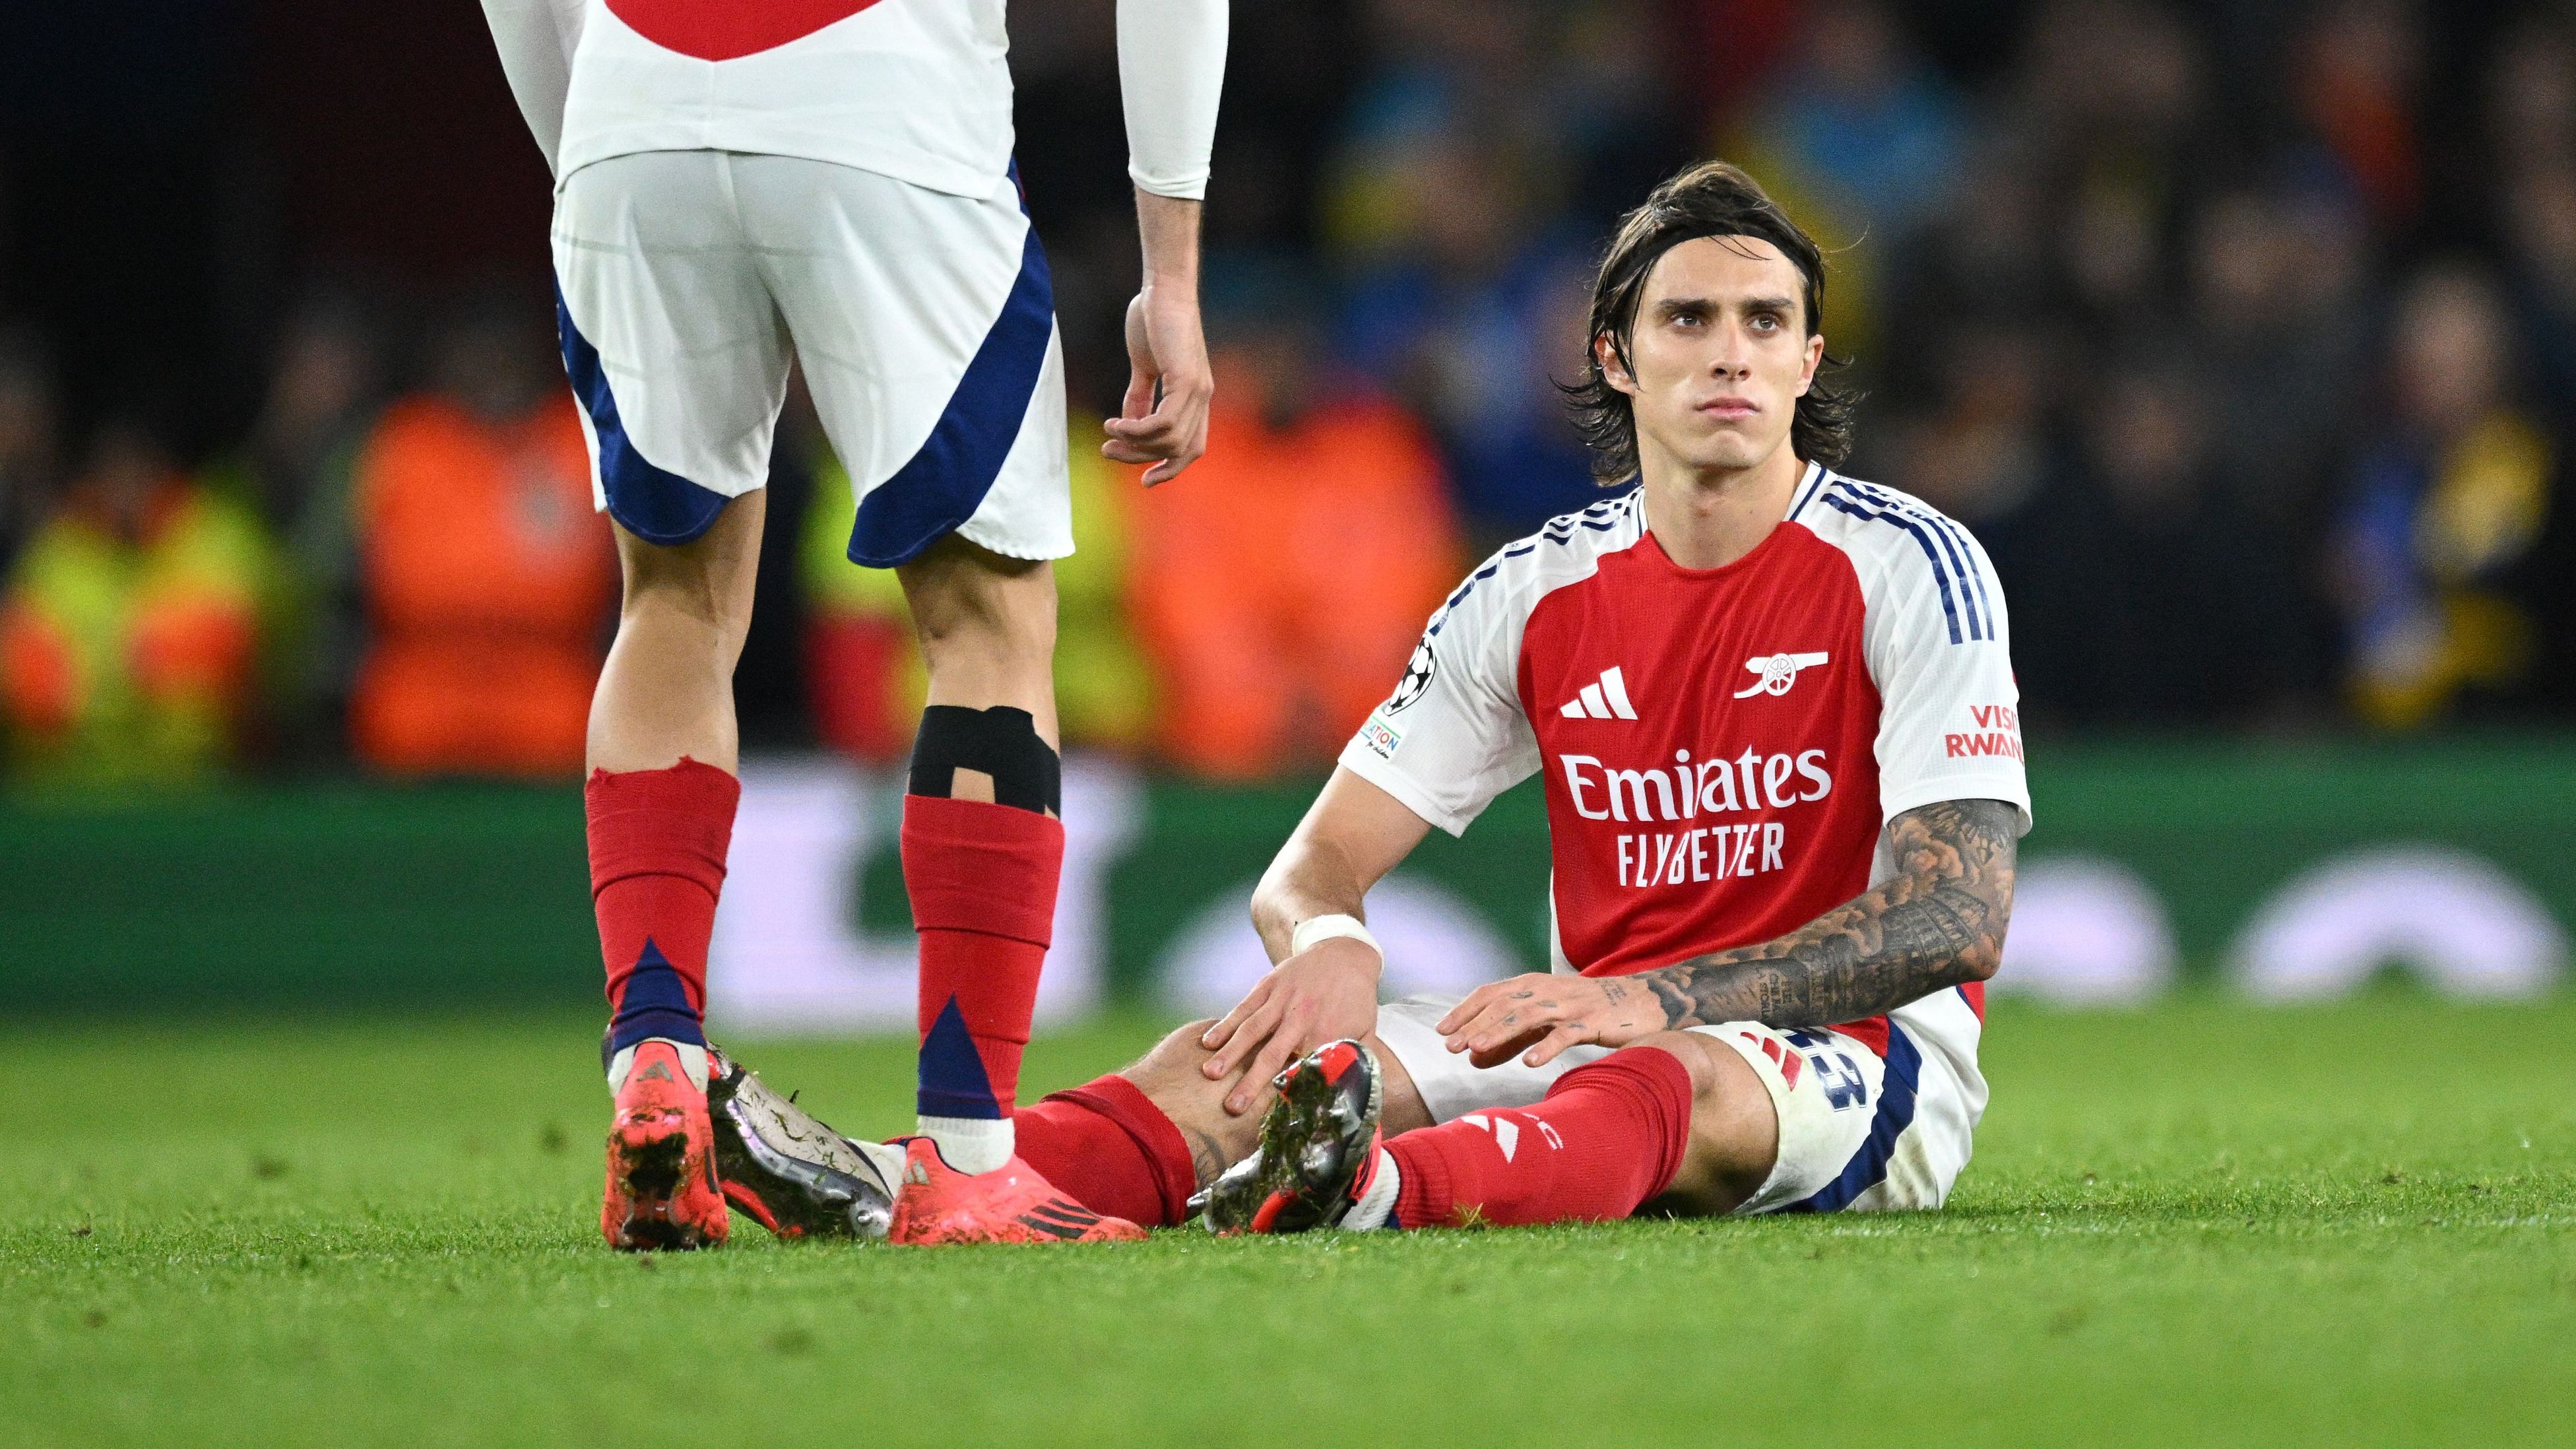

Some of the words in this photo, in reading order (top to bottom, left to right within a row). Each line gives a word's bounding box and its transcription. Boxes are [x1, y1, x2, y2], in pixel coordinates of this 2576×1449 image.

[1366, 722, 1399, 752] ATION
[1945, 733, 2024, 767] RWAN
[1559, 744, 1832, 822] Emirates
